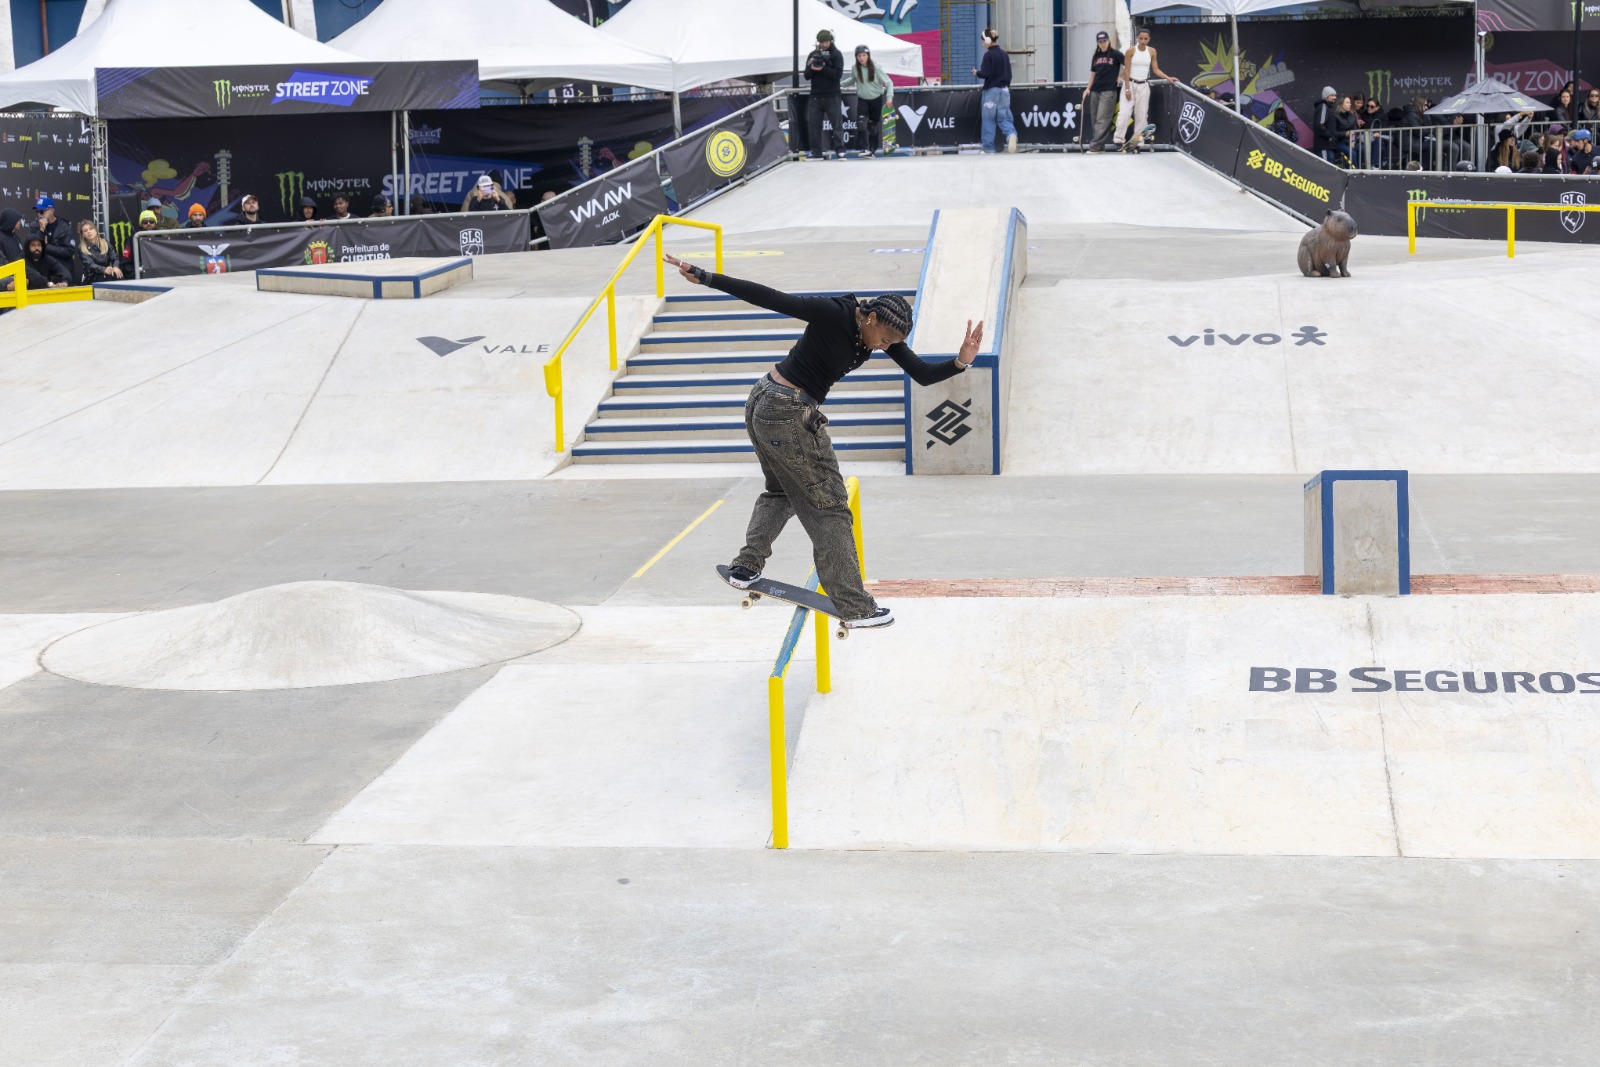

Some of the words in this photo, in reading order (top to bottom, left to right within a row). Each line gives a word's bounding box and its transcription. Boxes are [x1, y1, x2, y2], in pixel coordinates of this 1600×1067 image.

[231, 83, 270, 93] MONSTER
[275, 81, 330, 98] STREET
[331, 80, 369, 96] ZONE
[1393, 76, 1453, 88] MONSTER
[1464, 70, 1521, 91] PRK
[927, 117, 955, 129] VALE
[1021, 104, 1061, 128] vivo
[1182, 103, 1203, 125] SLS
[408, 127, 442, 140] SELECT
[306, 177, 371, 191] MONSTER
[380, 171, 469, 196] STREET
[1264, 157, 1284, 179] BB
[1282, 167, 1331, 203] SEGUROS
[569, 181, 632, 223] WAAW
[461, 230, 481, 244] SLS
[341, 244, 379, 254] Prefeitura
[379, 243, 390, 251] de
[1166, 328, 1282, 347] vivo
[482, 344, 551, 354] VALE
[1249, 666, 1338, 694] BB
[1349, 666, 1600, 694] SEGUROS
